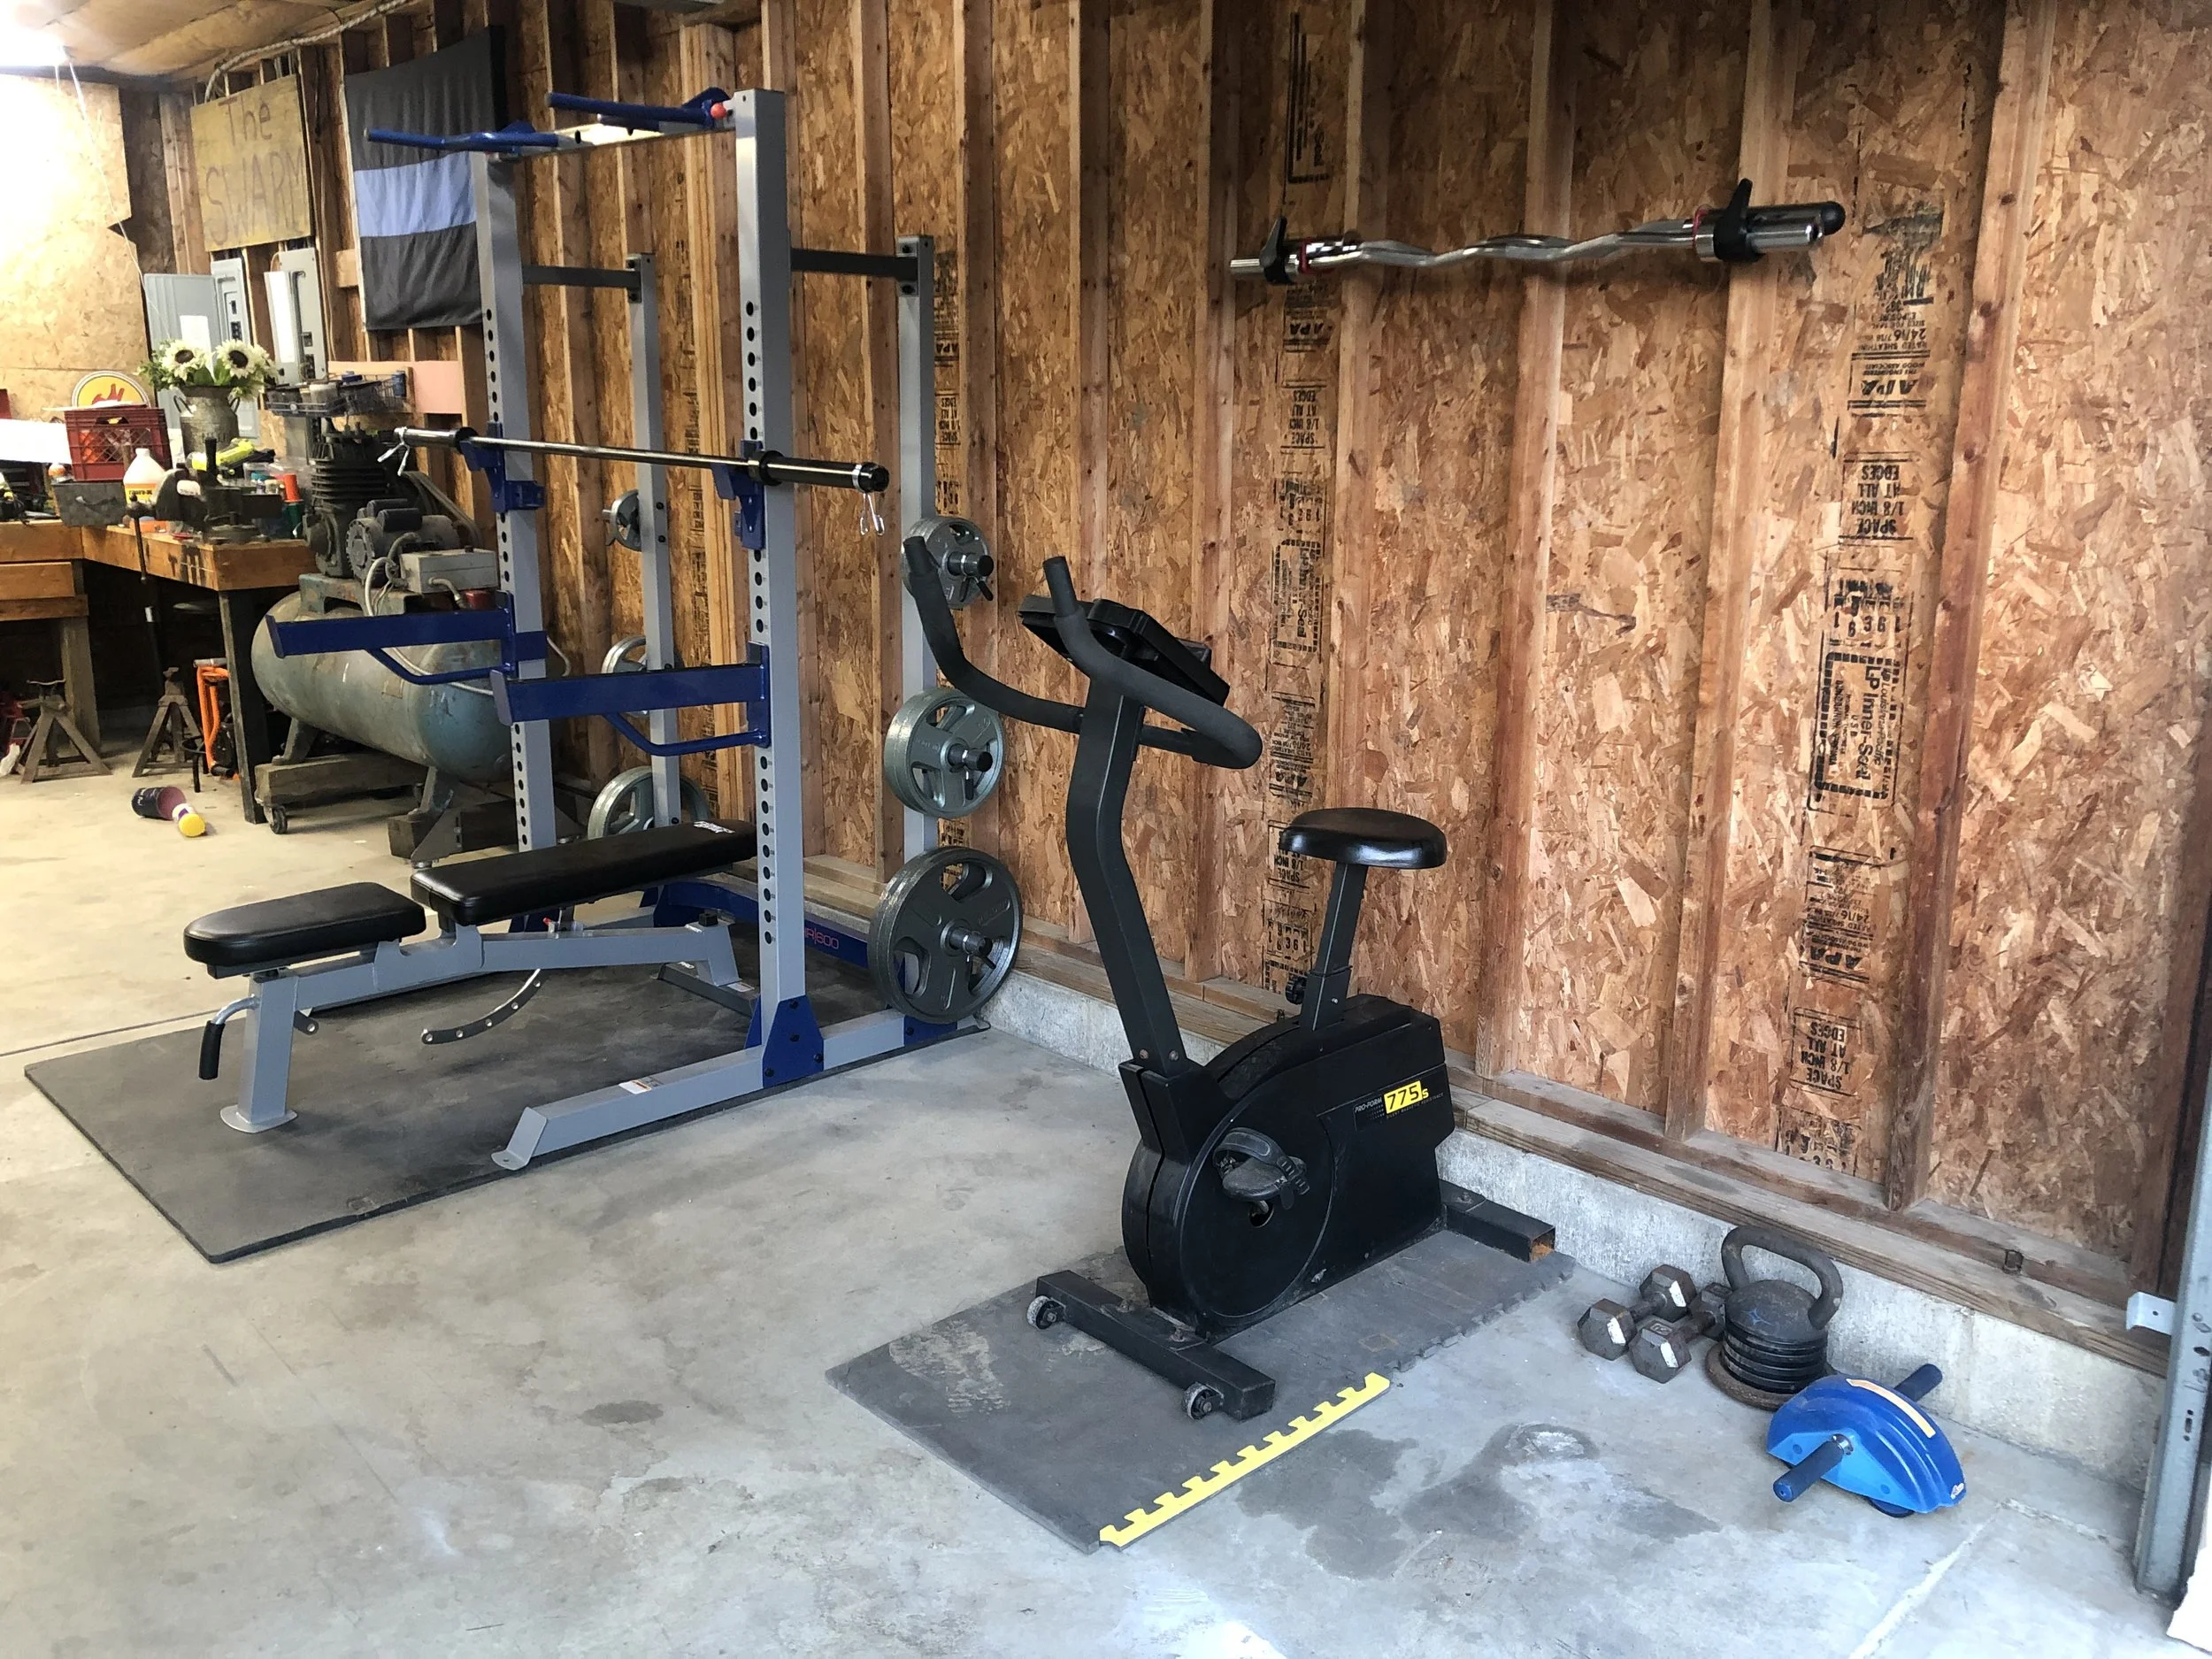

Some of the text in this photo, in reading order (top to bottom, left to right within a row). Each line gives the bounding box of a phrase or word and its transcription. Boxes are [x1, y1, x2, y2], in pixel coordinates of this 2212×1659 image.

[218, 93, 273, 145] The
[205, 148, 305, 245] SWARM
[1293, 390, 1316, 402] EDGES
[1307, 404, 1317, 416] AT
[1291, 432, 1315, 444] SPACE
[1862, 465, 1900, 480] EDGES
[1858, 482, 1901, 498] AT ALL
[1852, 500, 1904, 516] 1/8 INCH
[1856, 518, 1896, 534] SPACE
[1274, 855, 1303, 871] 1/8 INCH
[1278, 868, 1300, 882] SPACE
[1840, 910, 1869, 923] 24/16
[1809, 946, 1862, 970] APA
[1809, 1021, 1845, 1042] EDGES
[1807, 1036, 1847, 1058] AT ALL
[1801, 1050, 1850, 1075] 1/8 INCH
[1806, 1067, 1842, 1090] SPACE
